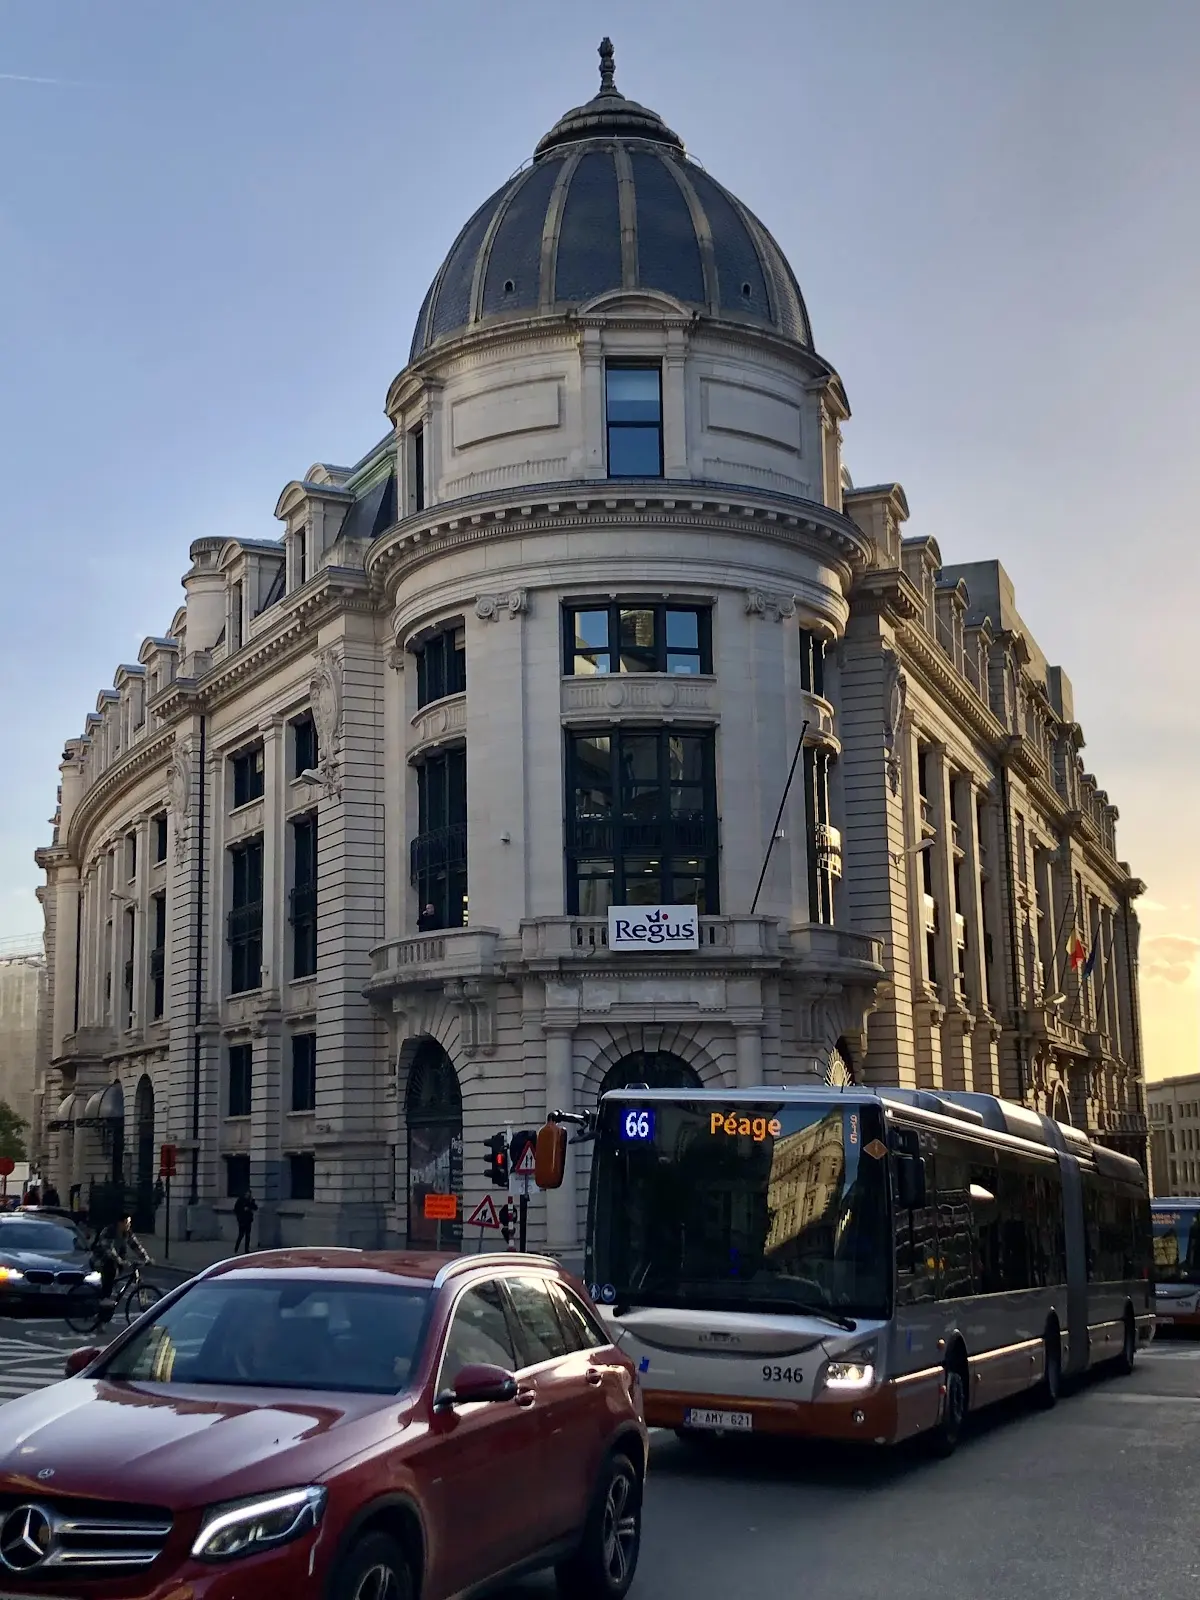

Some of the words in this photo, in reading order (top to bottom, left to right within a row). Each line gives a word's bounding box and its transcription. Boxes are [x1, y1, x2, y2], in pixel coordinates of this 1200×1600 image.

[615, 919, 695, 944] Regus
[625, 1111, 650, 1138] 66
[710, 1112, 782, 1142] Péage
[762, 1365, 803, 1384] 9346
